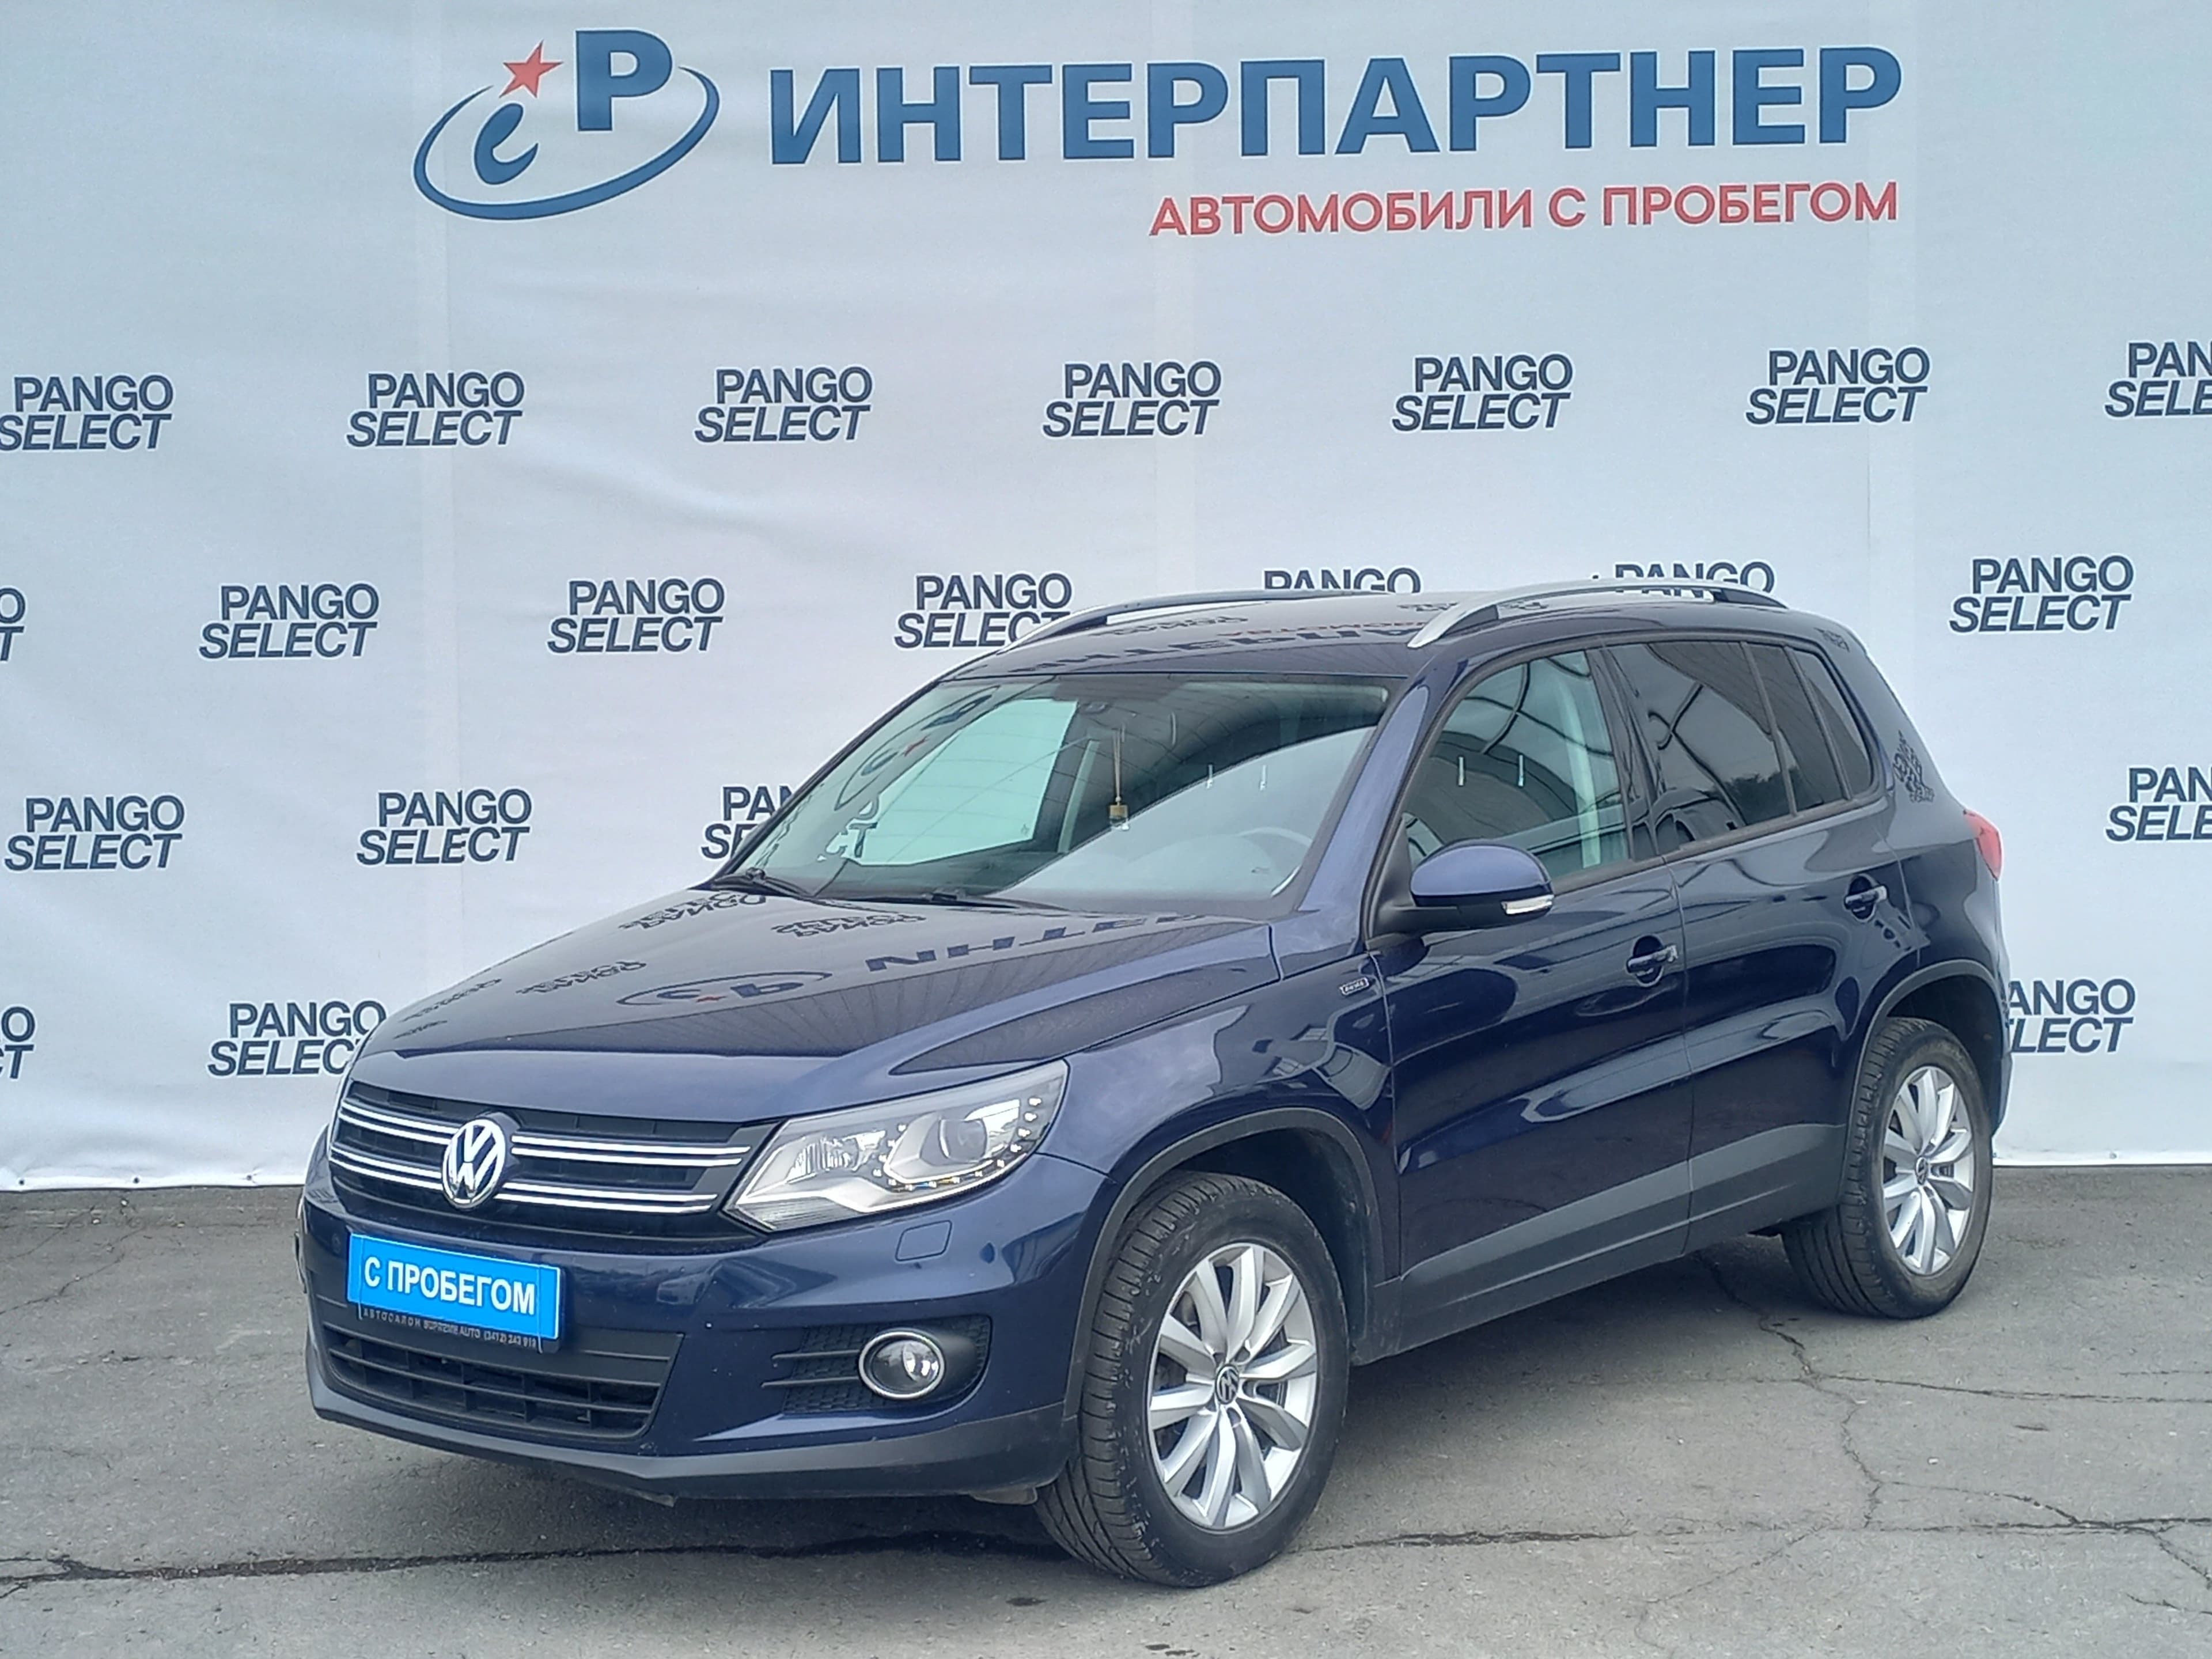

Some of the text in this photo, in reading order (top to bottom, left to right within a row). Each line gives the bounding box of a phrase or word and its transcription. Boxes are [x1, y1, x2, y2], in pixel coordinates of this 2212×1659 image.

[771, 47, 1901, 165] ИНТЕРПАРТНЕР
[1149, 181, 1896, 236] АВТОМОБИЛИ С ПРОБЕГОМ
[717, 366, 872, 404] PANGO
[1065, 361, 1221, 399] PANGO
[1415, 354, 1573, 392] PANGO
[1770, 347, 1930, 387] PANGO
[14, 375, 173, 413] PANGO
[369, 372, 525, 409] PANGO
[1747, 387, 1928, 425] SELECT
[347, 410, 523, 447] SELECT
[695, 404, 871, 443] SELECT
[1043, 399, 1220, 437] SELECT
[1392, 392, 1571, 431] SELECT
[0, 413, 172, 451] SELECT
[917, 573, 1072, 611] PANGO
[1974, 555, 2134, 594] PANGO
[222, 583, 379, 621] PANGO
[570, 578, 725, 615] PANGO
[1950, 594, 2131, 632] SELECT
[199, 621, 378, 660] SELECT
[548, 616, 724, 653] SELECT
[26, 795, 184, 833] PANGO
[379, 789, 532, 827] PANGO
[5, 833, 183, 872] SELECT
[357, 826, 531, 863] SELECT
[230, 1000, 387, 1038] PANGO
[364, 1256, 536, 1316] С ПРОБЕГОМ
